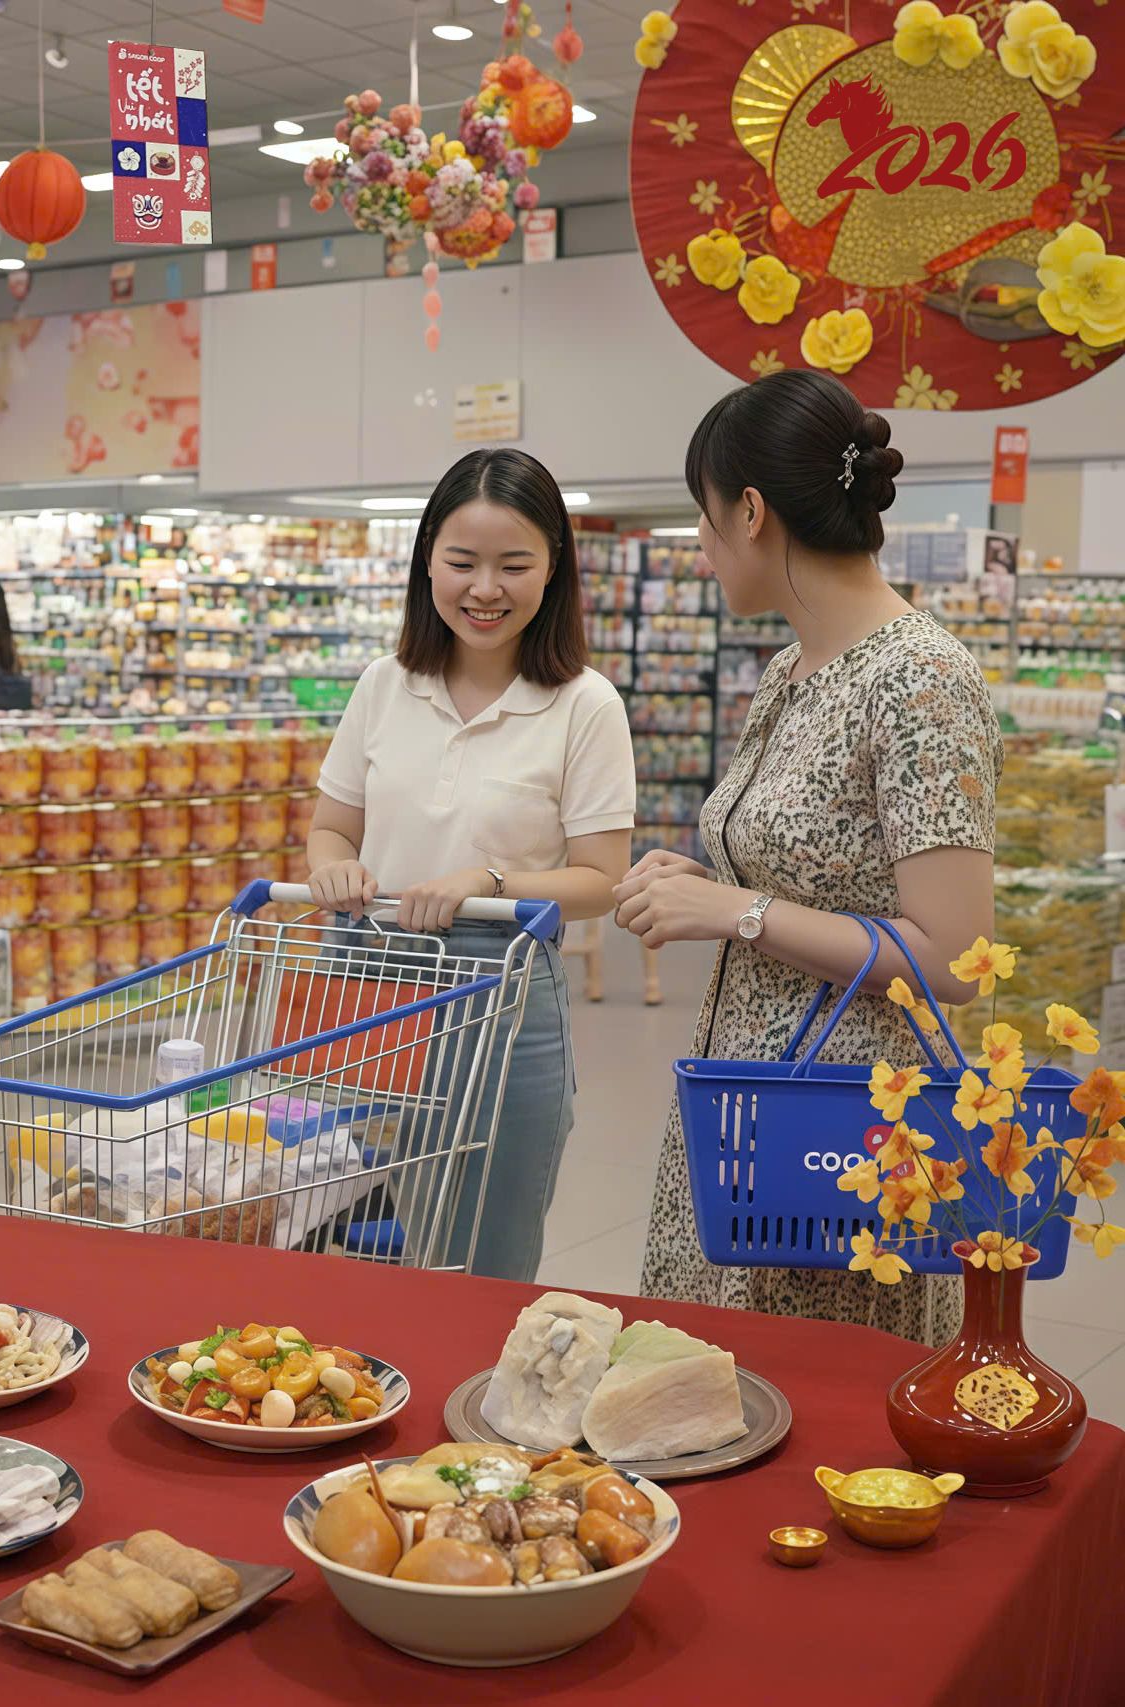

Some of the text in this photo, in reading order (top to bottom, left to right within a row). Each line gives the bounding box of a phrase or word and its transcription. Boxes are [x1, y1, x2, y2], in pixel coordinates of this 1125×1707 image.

[126, 67, 164, 105] tết
[126, 104, 174, 135] nhất
[816, 112, 1026, 200] 2026
[803, 1151, 866, 1172] COO
